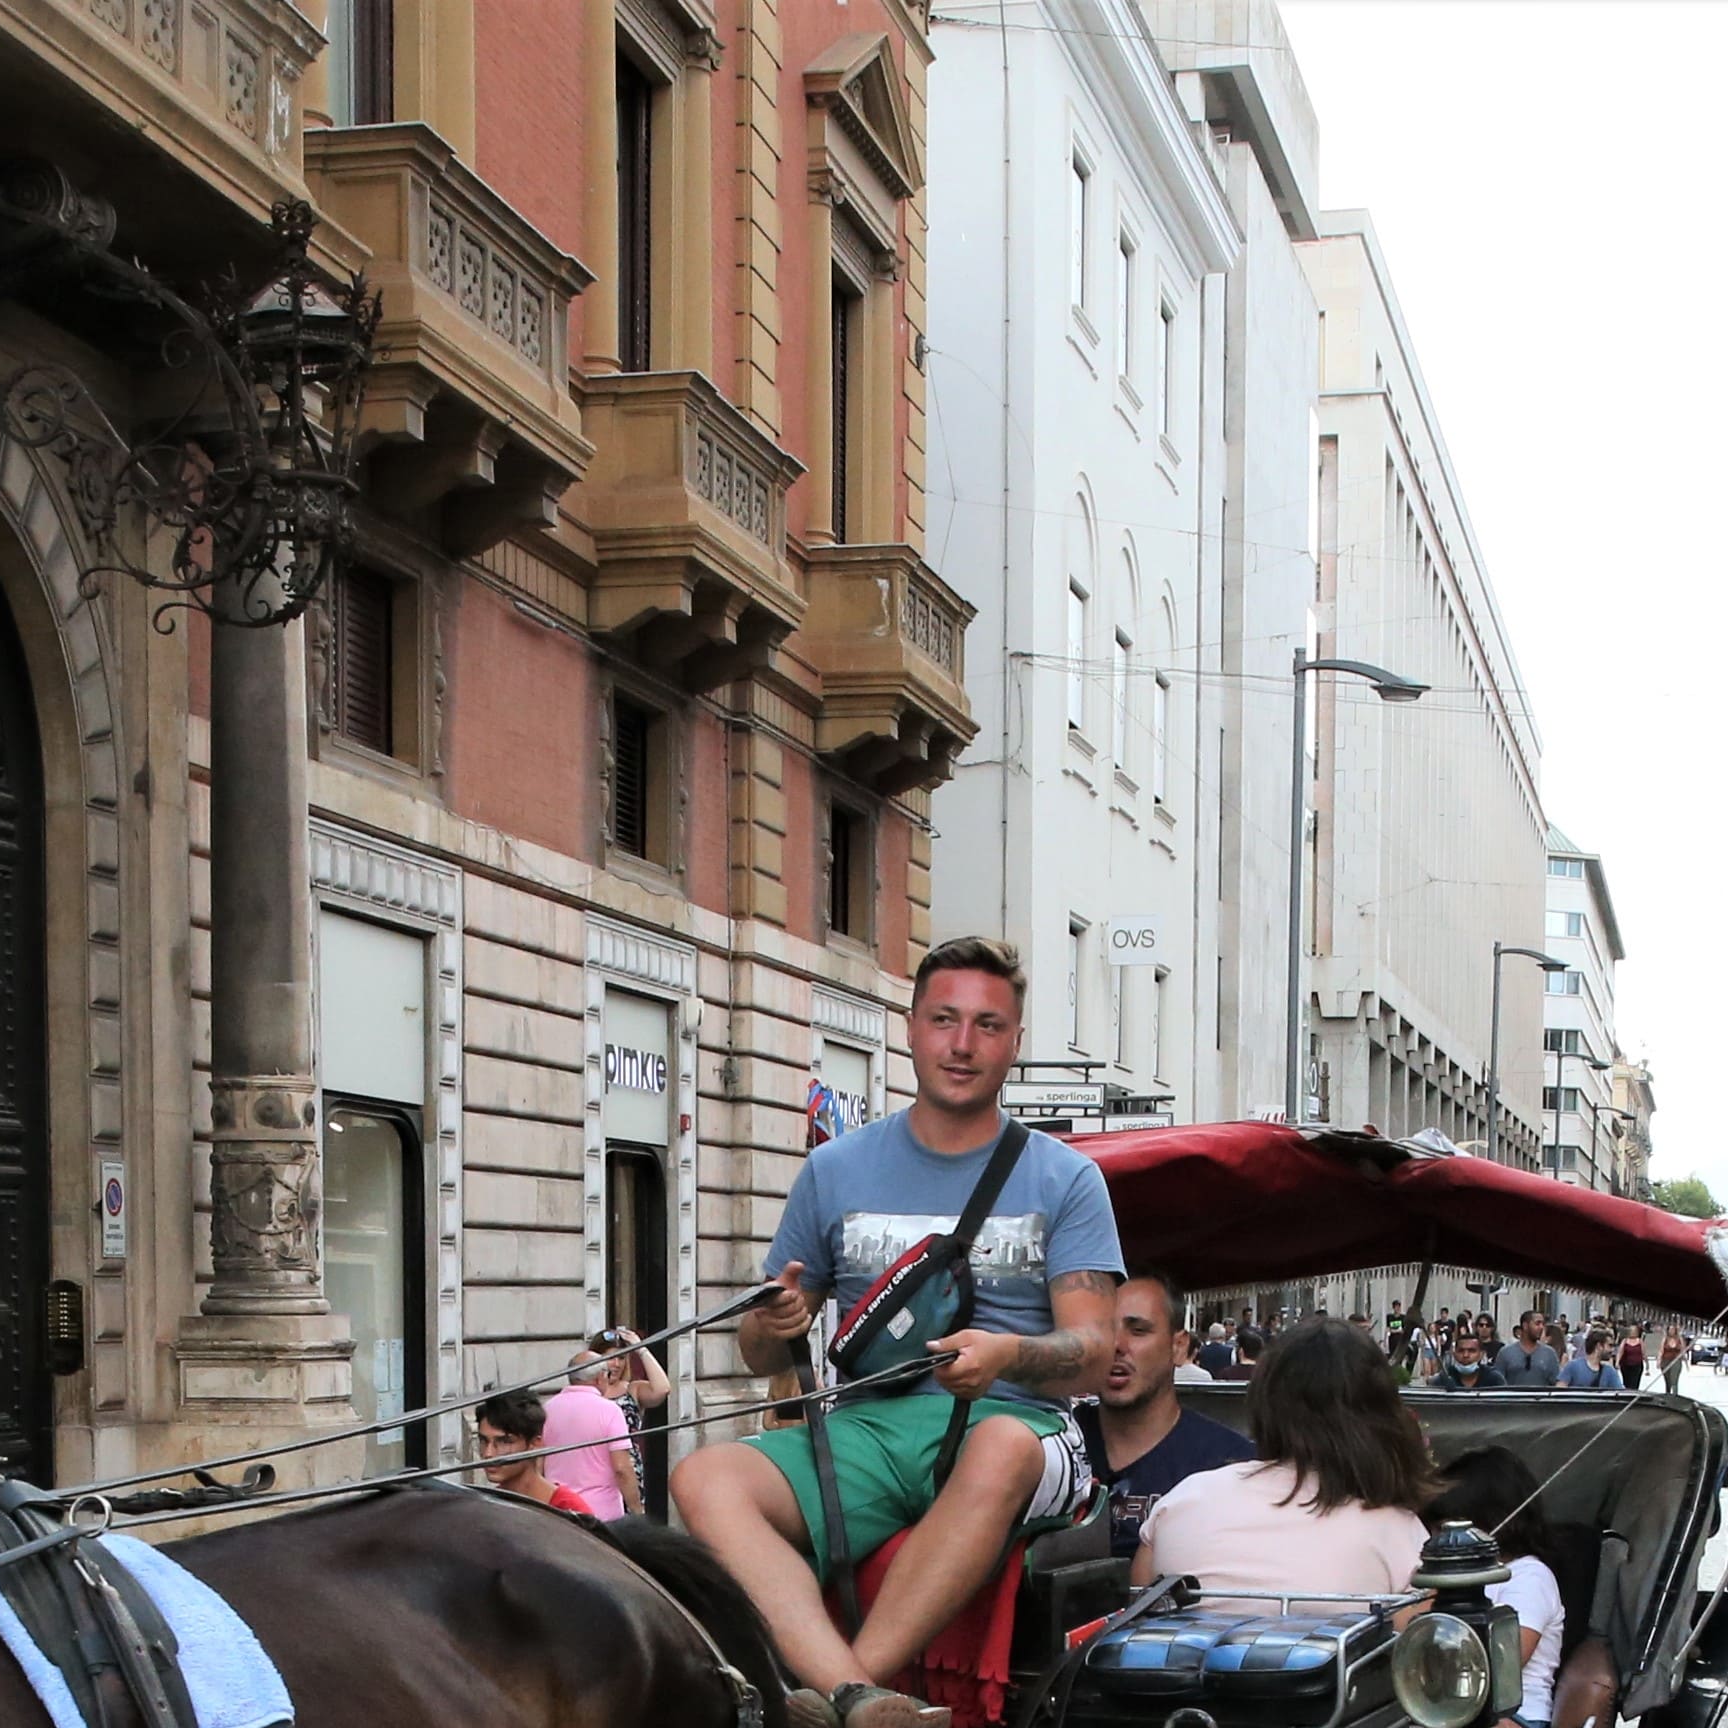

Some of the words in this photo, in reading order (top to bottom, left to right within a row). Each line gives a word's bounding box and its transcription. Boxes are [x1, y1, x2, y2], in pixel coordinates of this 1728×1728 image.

[1112, 929, 1156, 949] OVS
[605, 1044, 667, 1094] pimkie
[1046, 1091, 1097, 1103] sperlinga
[867, 1284, 894, 1314] SUPPLY
